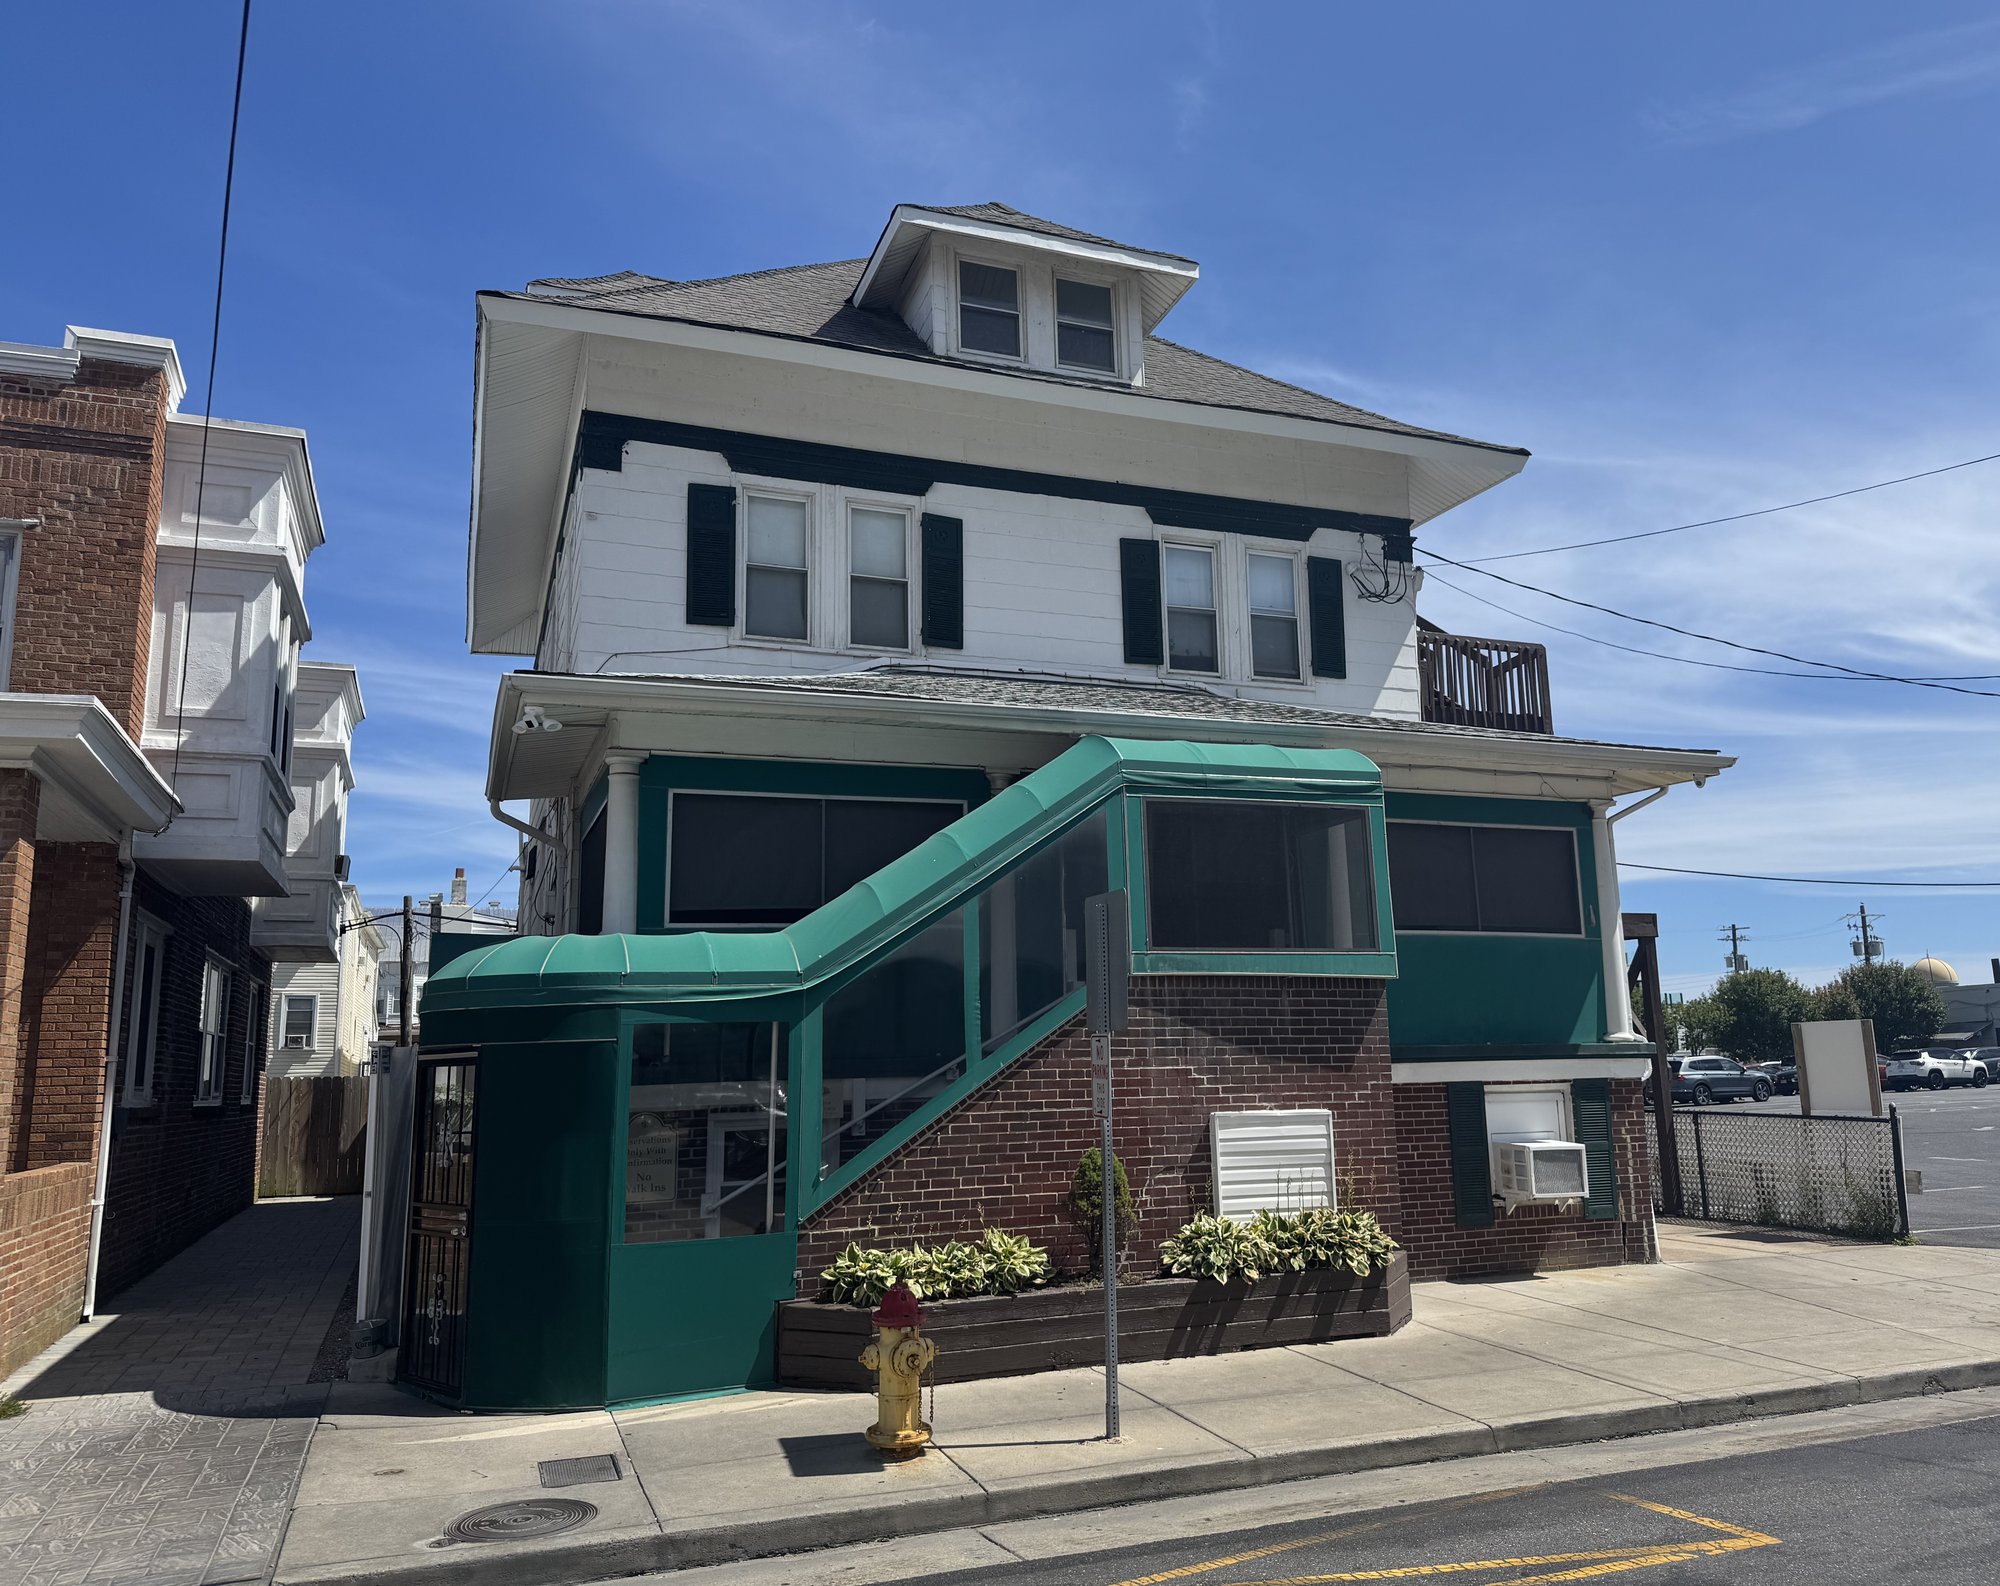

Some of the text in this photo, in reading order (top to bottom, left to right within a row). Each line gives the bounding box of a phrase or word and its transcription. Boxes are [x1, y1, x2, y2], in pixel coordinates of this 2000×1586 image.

[1097, 1045, 1104, 1060] NO
[1092, 1064, 1109, 1080] PARKING
[628, 1136, 672, 1145] servations
[646, 1147, 666, 1155] With
[627, 1157, 672, 1167] nfirmation
[637, 1173, 652, 1182] No
[650, 1183, 666, 1192] Ins
